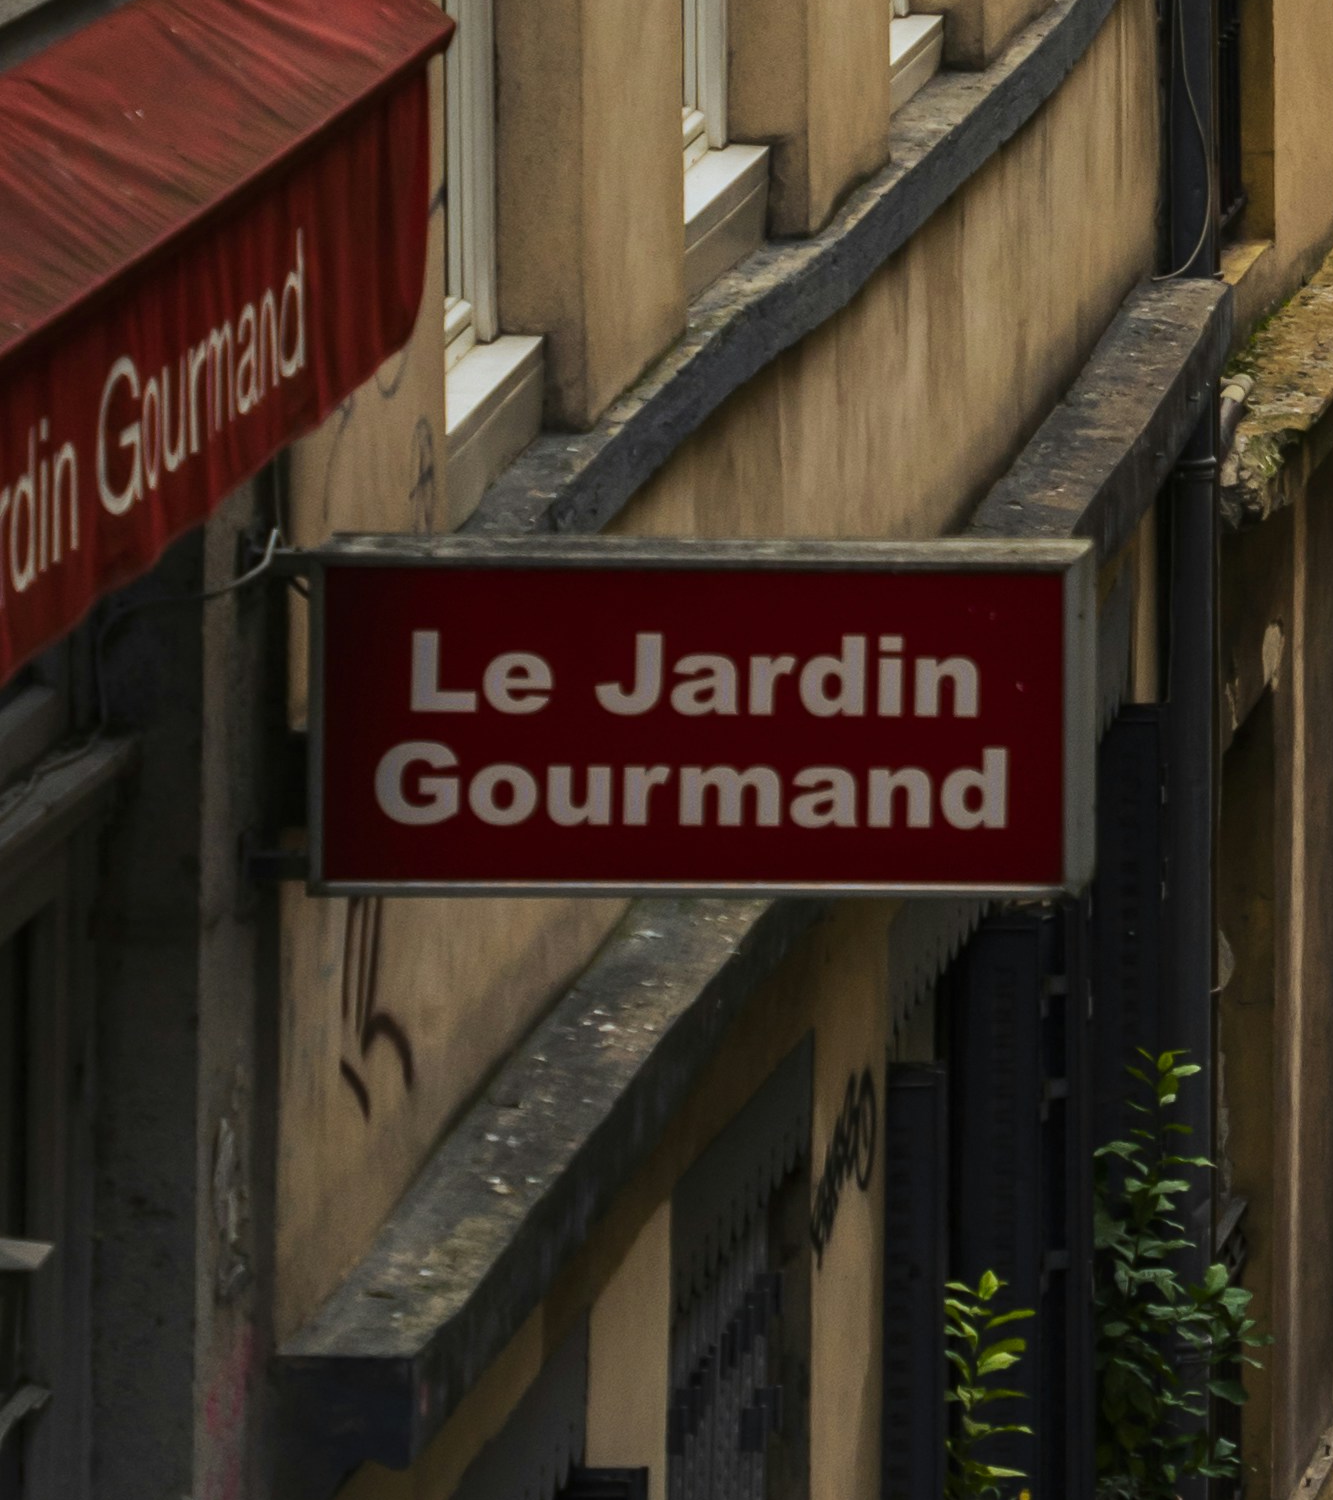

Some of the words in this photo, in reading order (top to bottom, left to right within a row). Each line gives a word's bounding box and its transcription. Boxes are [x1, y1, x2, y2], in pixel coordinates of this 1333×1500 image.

[0, 418, 80, 608] rdin
[97, 227, 306, 516] Gourmand
[410, 630, 554, 715] Le
[595, 632, 979, 718] Jardin
[375, 741, 1008, 830] Gourmand
